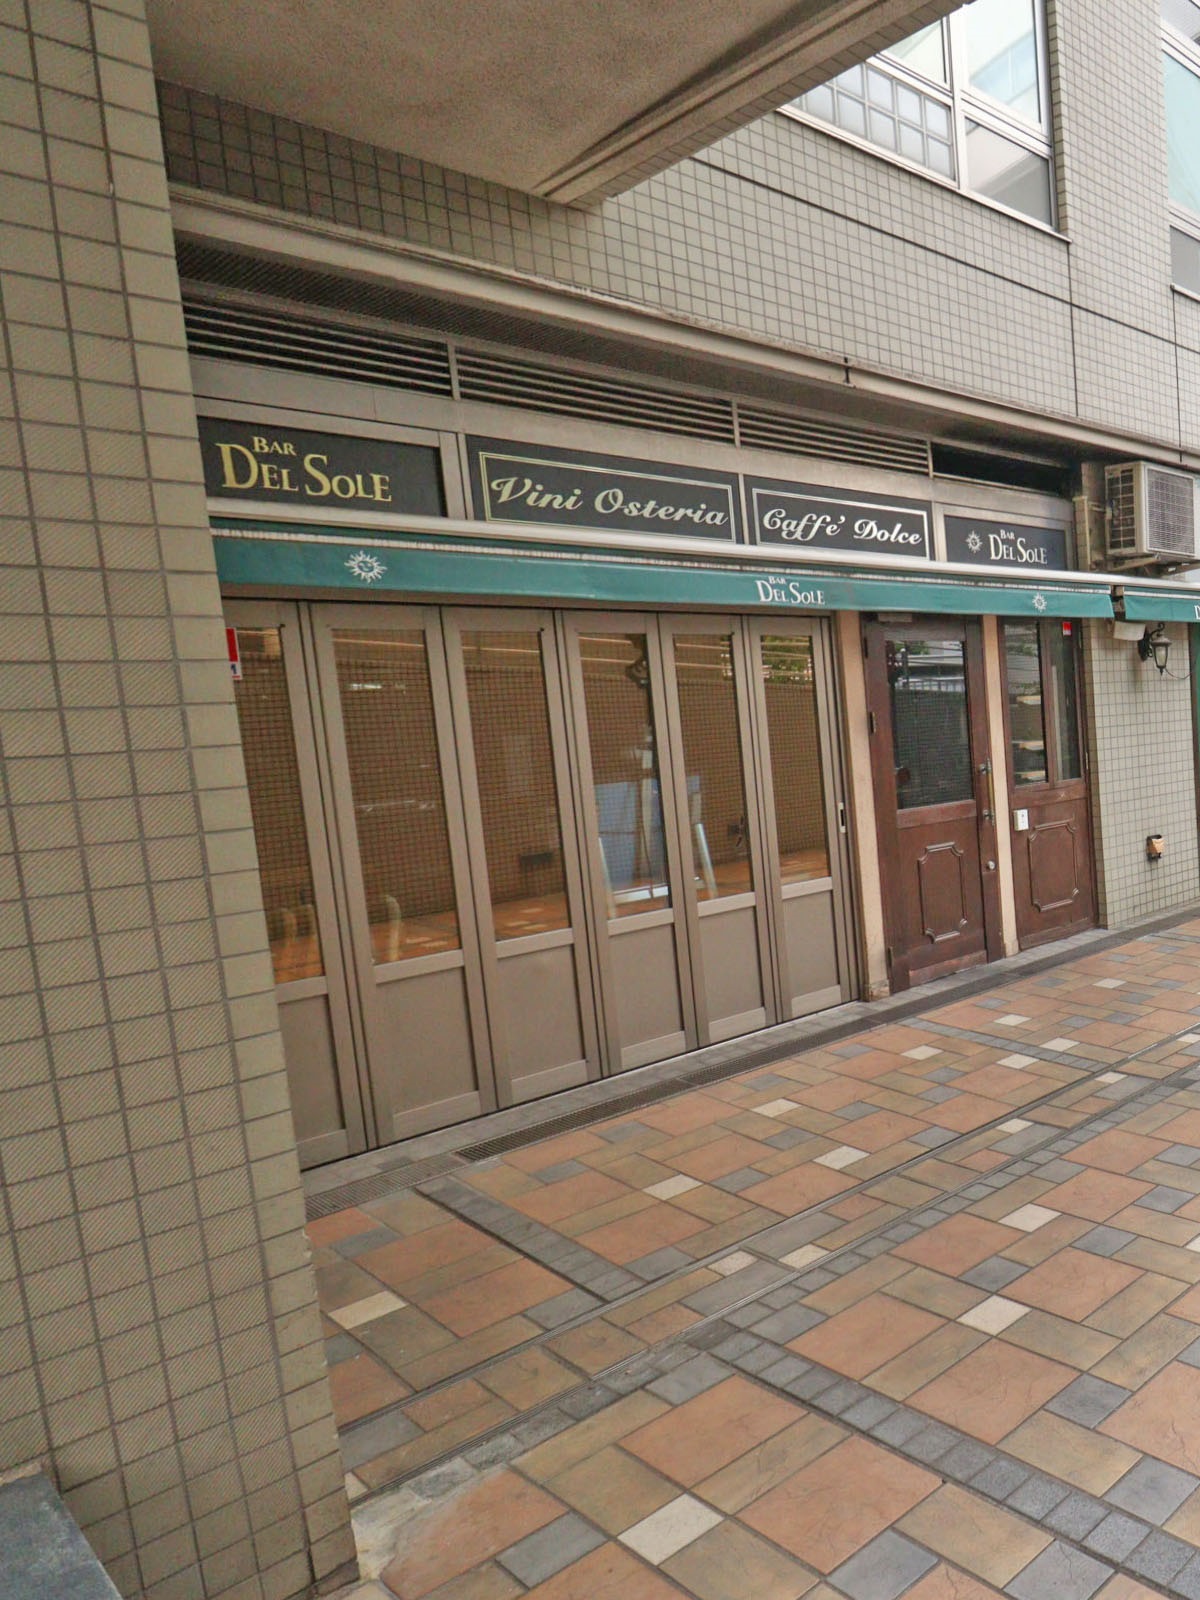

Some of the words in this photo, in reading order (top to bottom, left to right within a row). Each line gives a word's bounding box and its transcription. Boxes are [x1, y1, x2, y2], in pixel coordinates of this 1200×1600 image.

[252, 436, 297, 456] BAR
[215, 442, 299, 492] DEL
[303, 453, 393, 502] SOLE
[490, 476, 584, 511] Vini
[594, 487, 729, 526] Osteria
[853, 518, 923, 545] Dolce
[1000, 529, 1016, 540] BAR
[988, 534, 1016, 560] DEL
[1017, 537, 1048, 565] SOLE
[755, 580, 789, 602] DEL
[789, 582, 826, 605] SOLE
